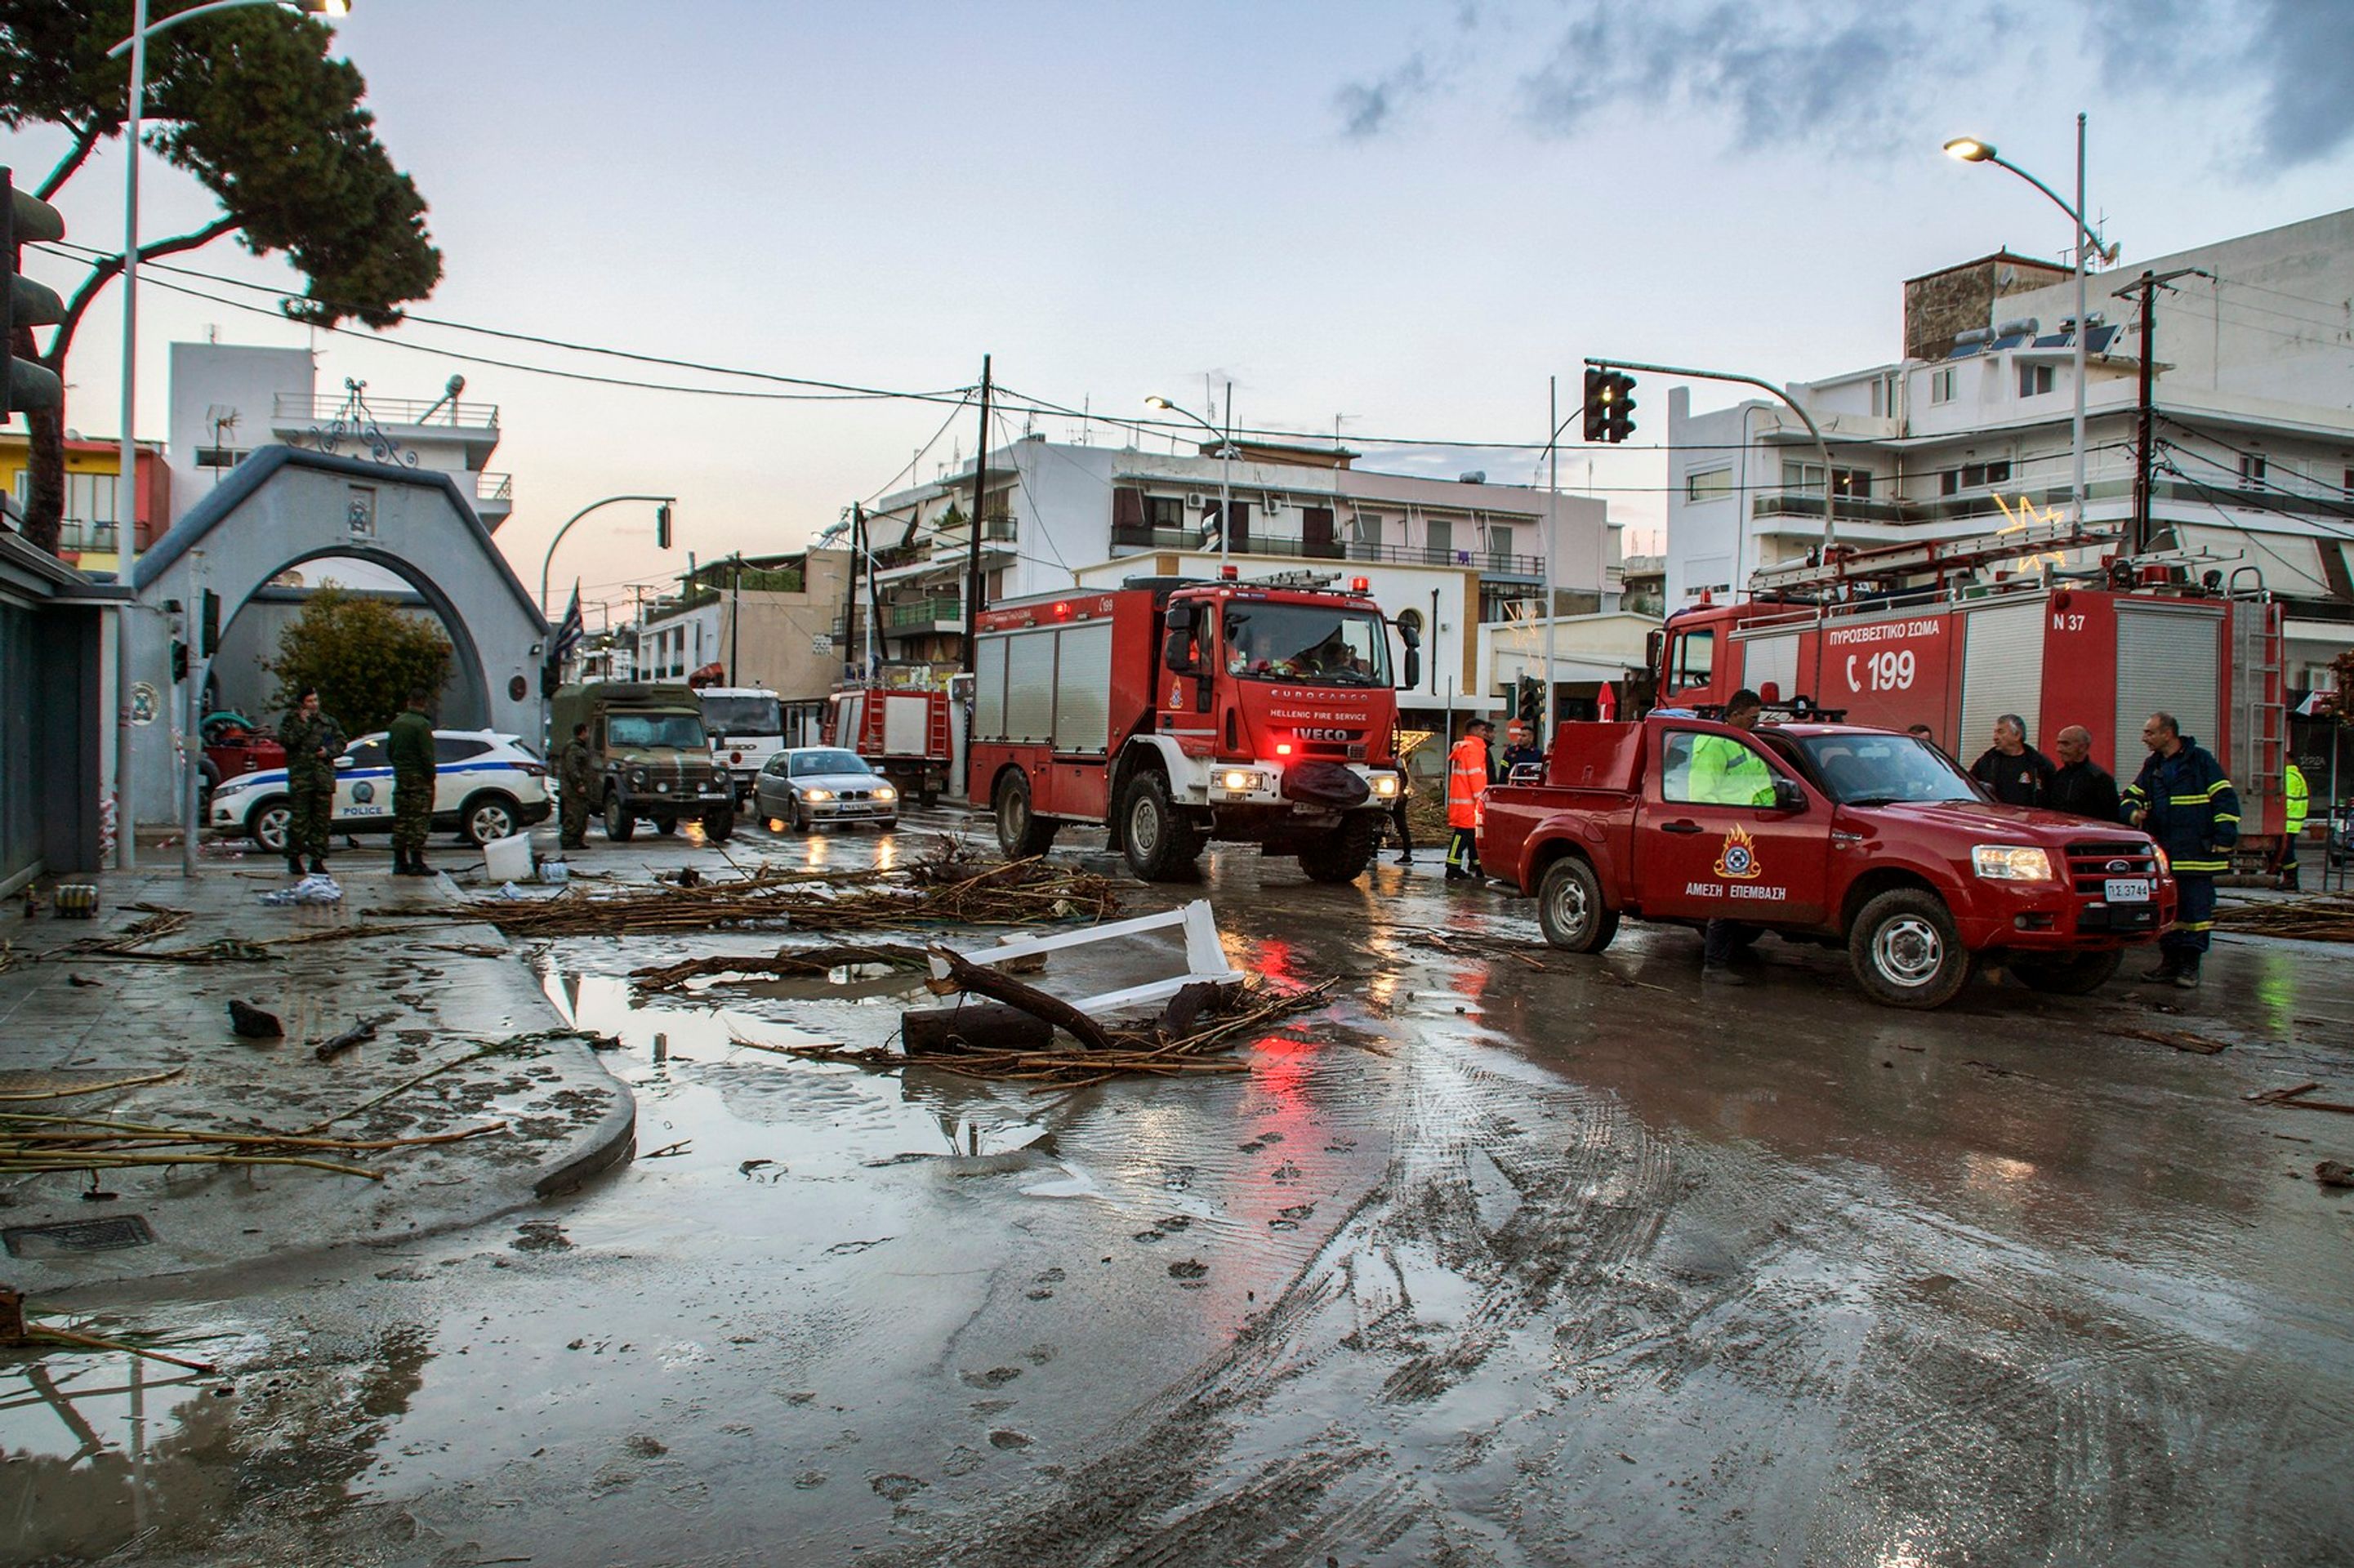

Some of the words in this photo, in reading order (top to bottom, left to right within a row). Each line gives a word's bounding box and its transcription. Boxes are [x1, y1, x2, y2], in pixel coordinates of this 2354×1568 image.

[1103, 599, 1113, 612] 199
[2069, 614, 2084, 630] 37
[1830, 623, 1906, 645] ΠΥΡΟΣΒΕΣΤΙΚΟ
[1907, 620, 1940, 637] ΣΩΜΑ
[1867, 650, 1915, 690] 199
[1270, 709, 1310, 719] HELLENIC
[1314, 711, 1331, 720] FIRE
[1335, 713, 1366, 721] SERVICE
[1292, 728, 1348, 741] IVECO
[344, 807, 382, 815] POLICE
[1686, 883, 1723, 897] ΑΜΕΣΗ
[1730, 885, 1786, 900] ΕΠΕΜΒΑΣΗ
[2124, 885, 2147, 896] 3744
